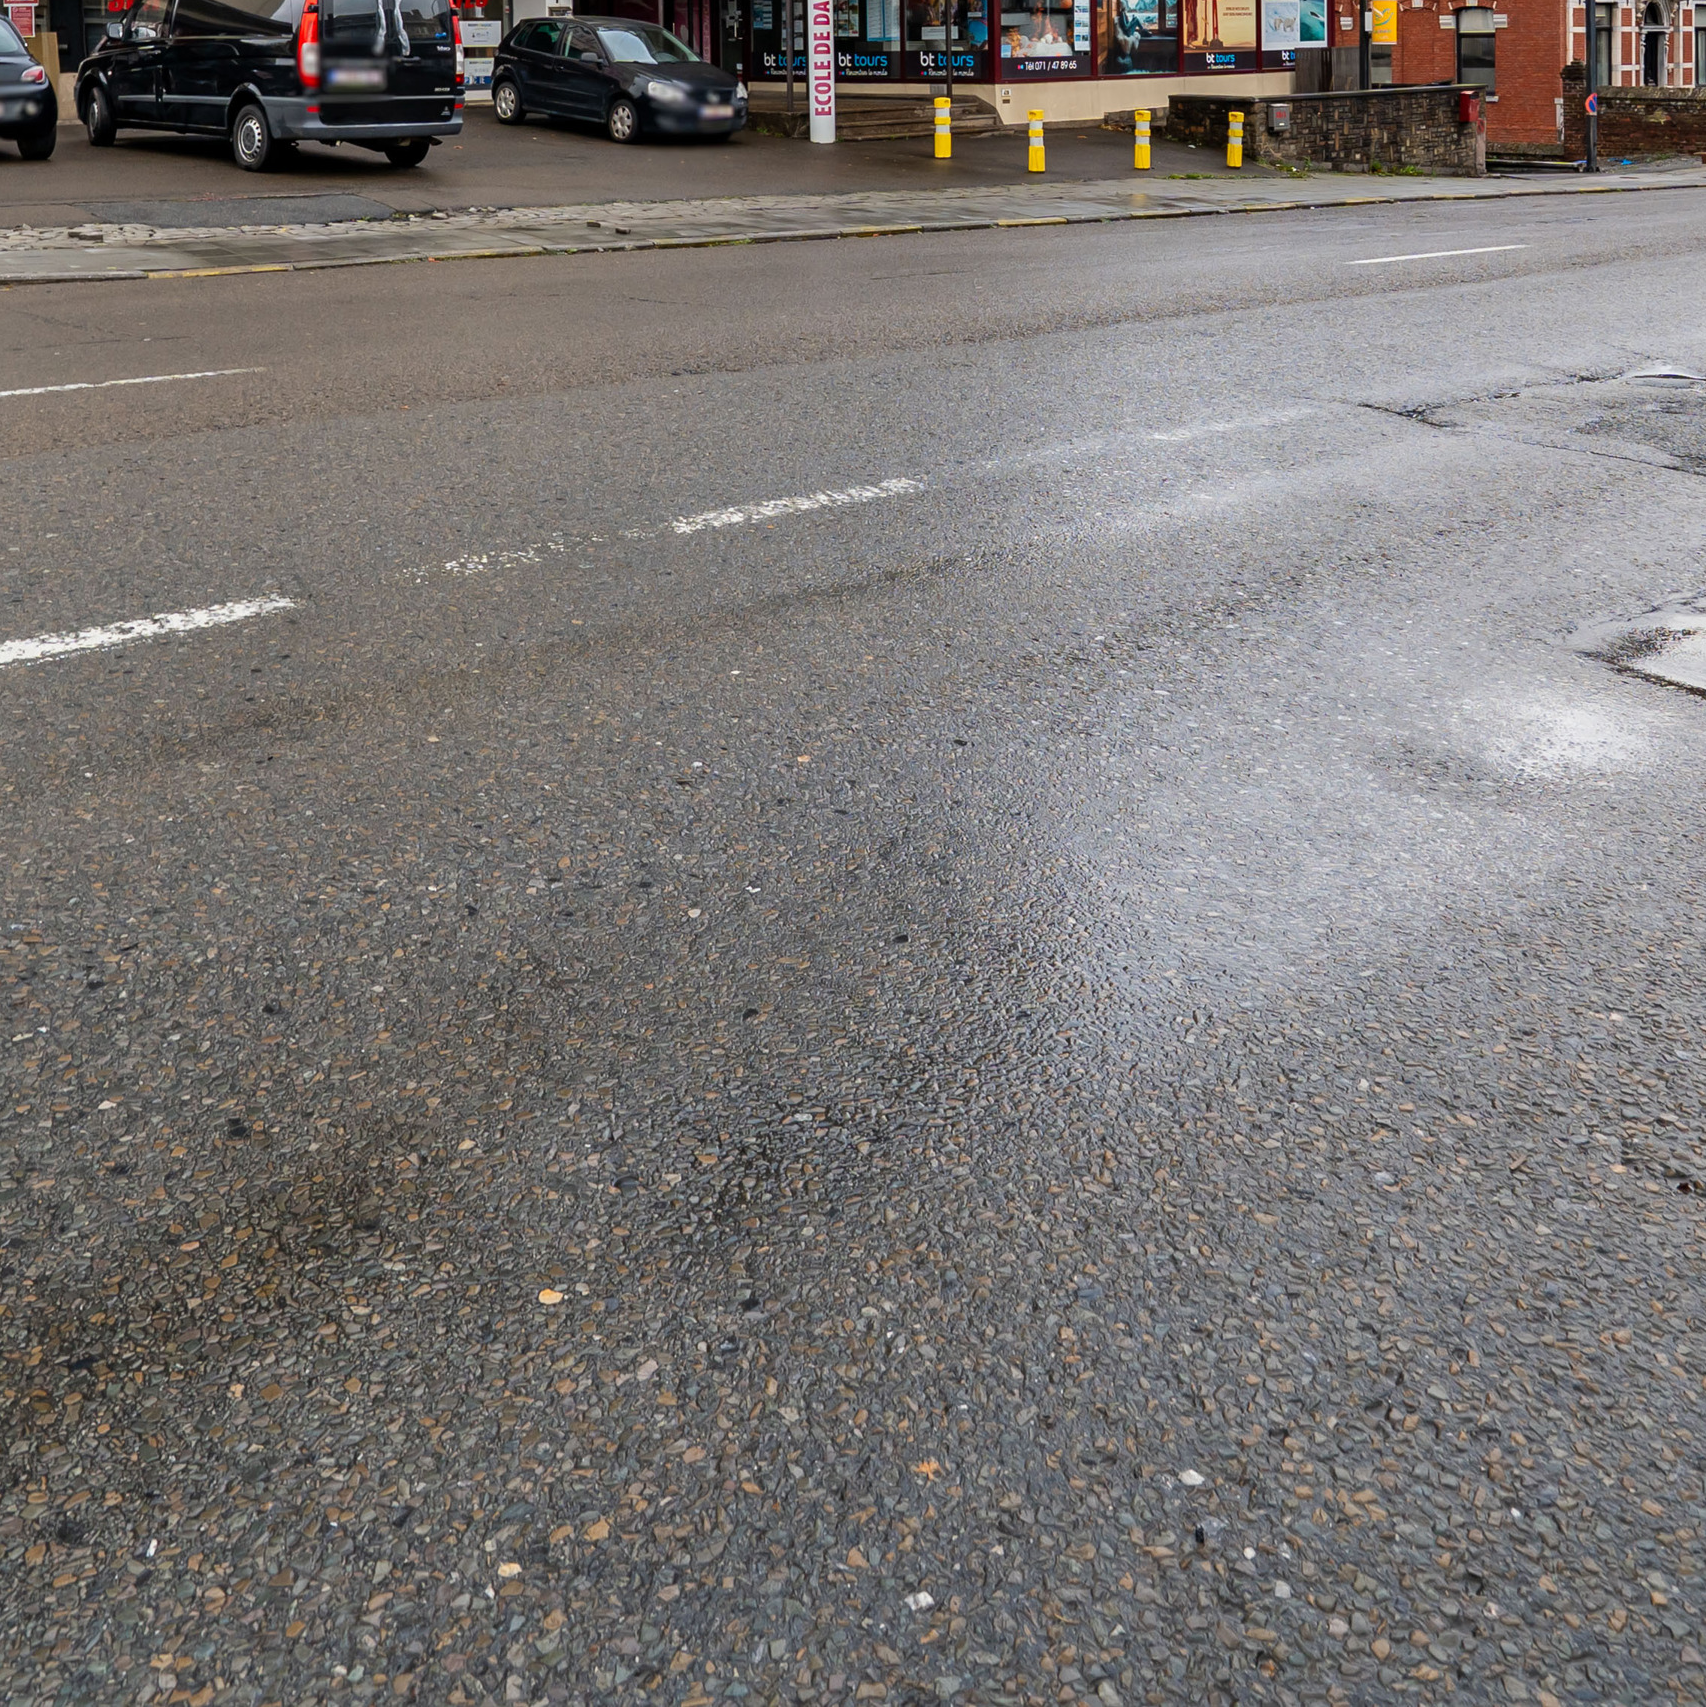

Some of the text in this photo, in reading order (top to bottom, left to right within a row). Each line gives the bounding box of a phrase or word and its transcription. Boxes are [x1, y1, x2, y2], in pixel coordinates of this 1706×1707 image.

[813, 31, 831, 55] DE
[763, 52, 776, 67] bt
[838, 52, 888, 67] bt tours
[920, 51, 934, 67] bt
[1206, 52, 1235, 63] bt tours
[814, 60, 832, 116] ECOLE
